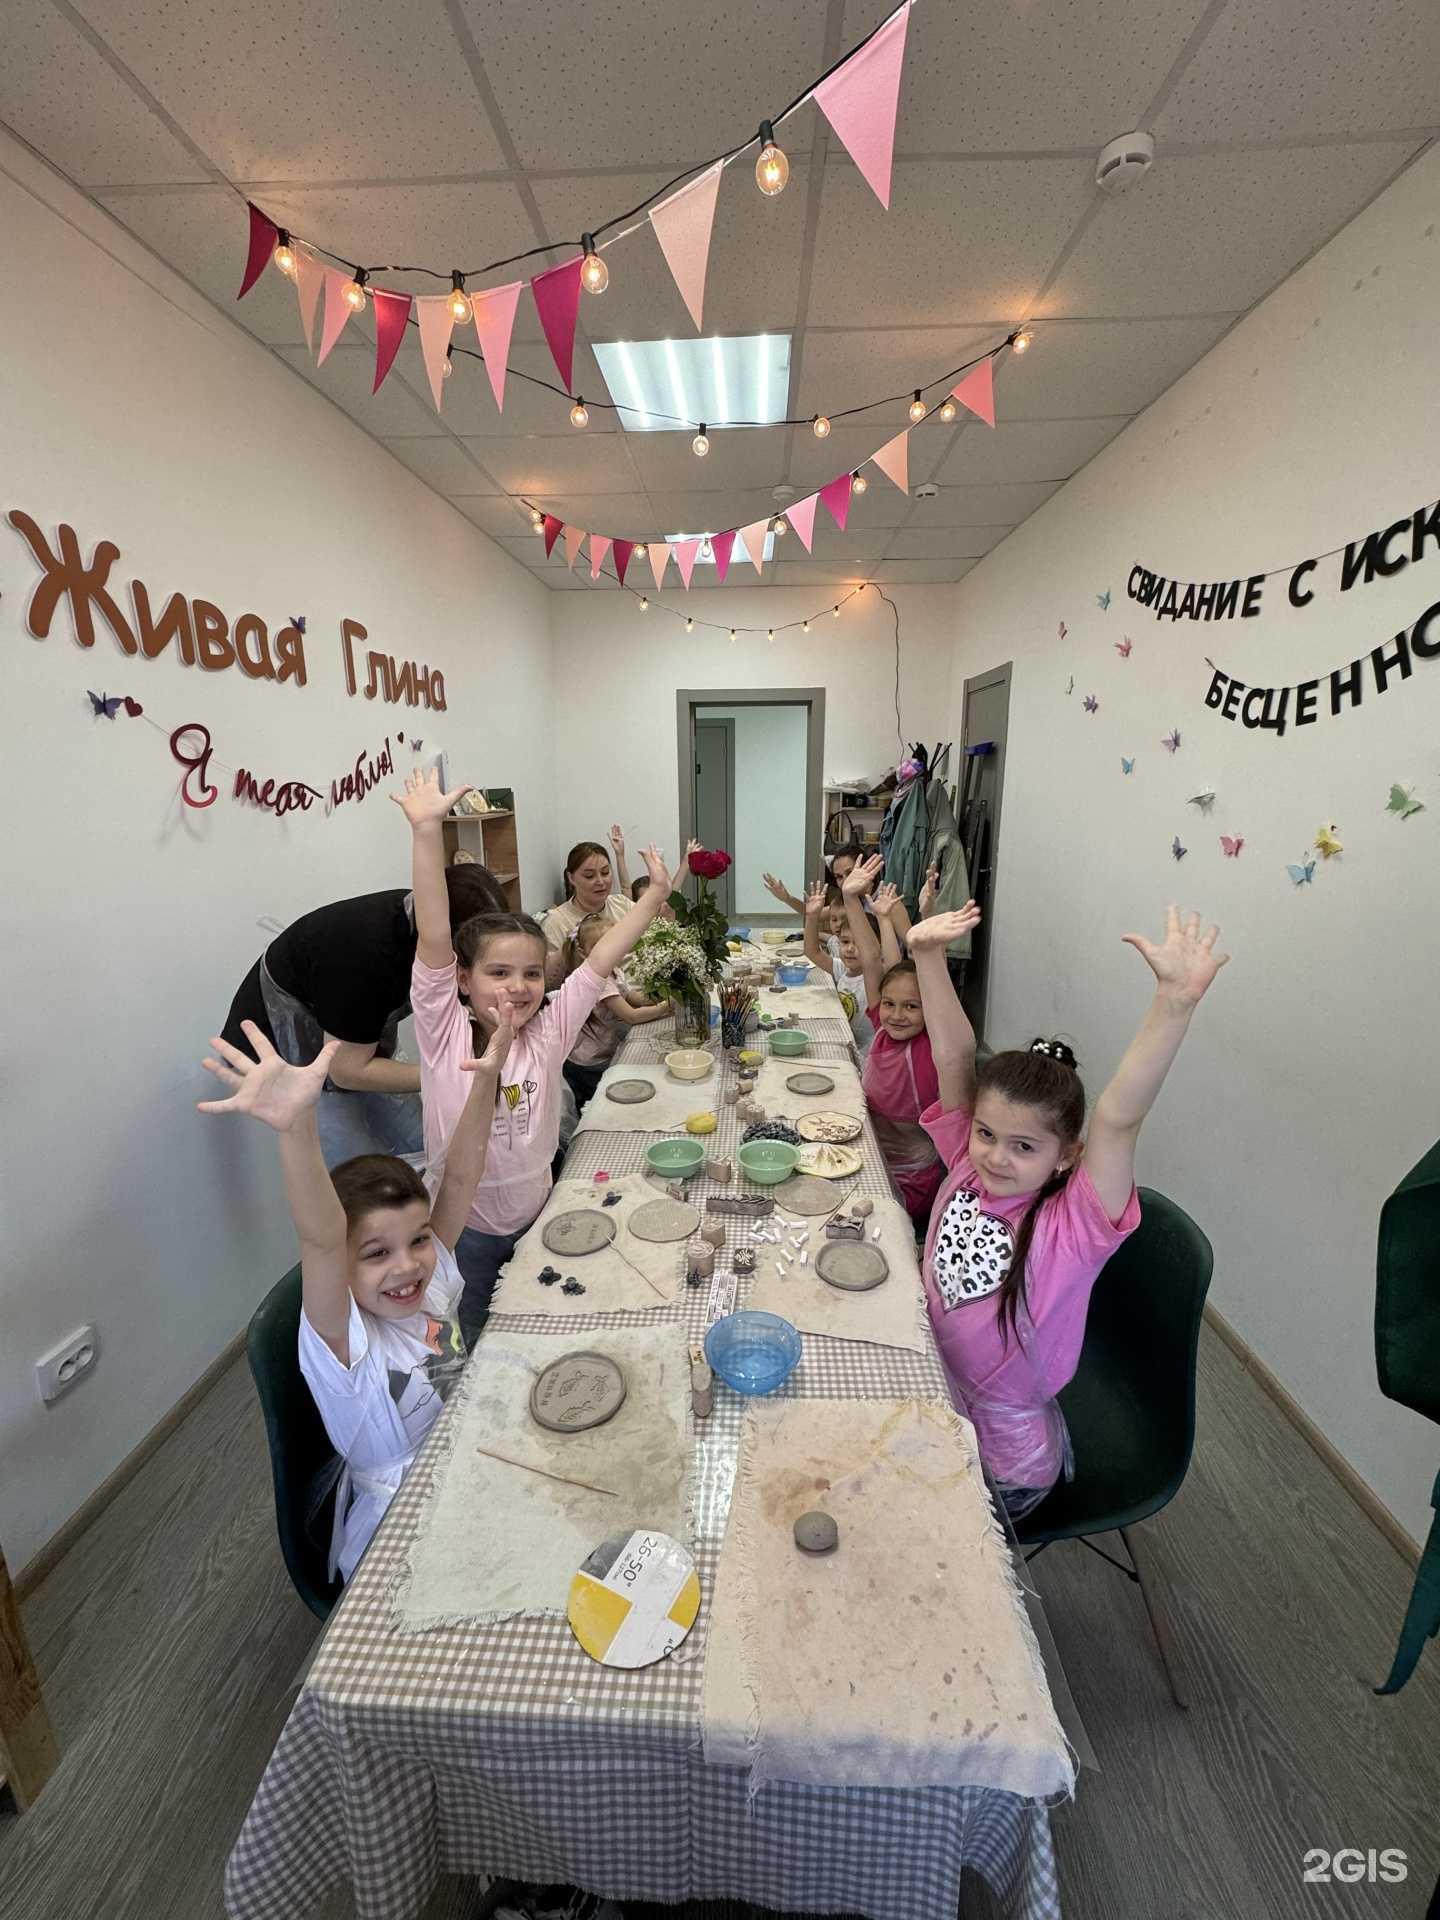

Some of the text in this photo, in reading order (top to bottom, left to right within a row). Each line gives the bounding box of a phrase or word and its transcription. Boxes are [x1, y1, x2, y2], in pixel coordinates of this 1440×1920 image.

[8, 509, 447, 711] Живая Глина
[1127, 565, 1265, 621] СВИДАНИЕ
[1288, 559, 1318, 607] С
[1205, 600, 1440, 737] БЕСЦЕННО
[170, 723, 218, 809] Я
